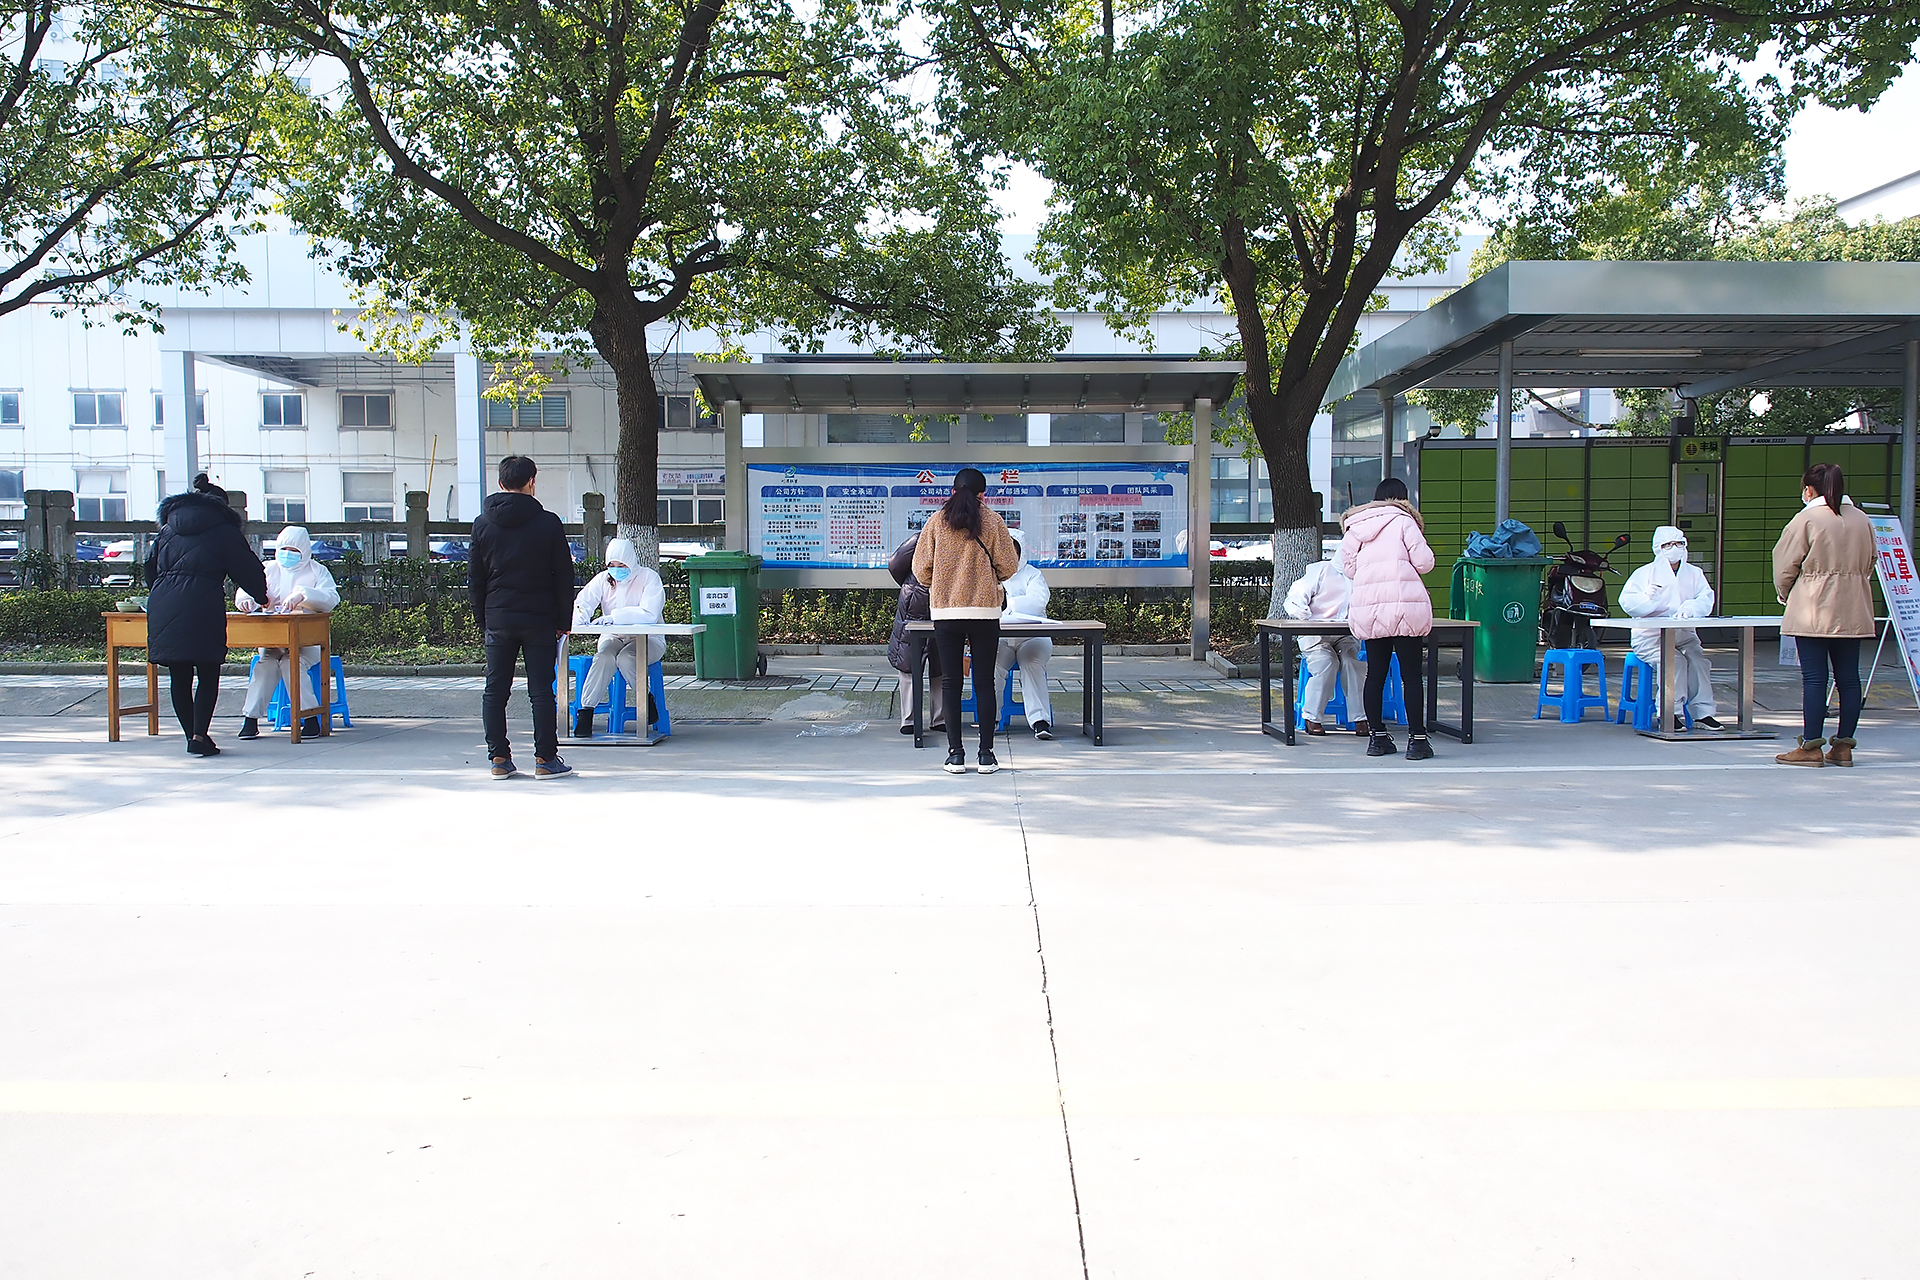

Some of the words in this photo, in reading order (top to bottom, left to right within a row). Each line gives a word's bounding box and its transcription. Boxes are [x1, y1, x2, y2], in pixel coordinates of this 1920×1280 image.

[1700, 441, 1718, 452] 丰巢
[916, 470, 935, 484] 公
[1000, 469, 1020, 484] 栏
[775, 488, 805, 496] 公司方针
[842, 488, 873, 496] 安全承诺
[920, 488, 951, 496] 公司动态
[1062, 487, 1093, 495] 管理知识
[1127, 486, 1158, 494] 团队风采
